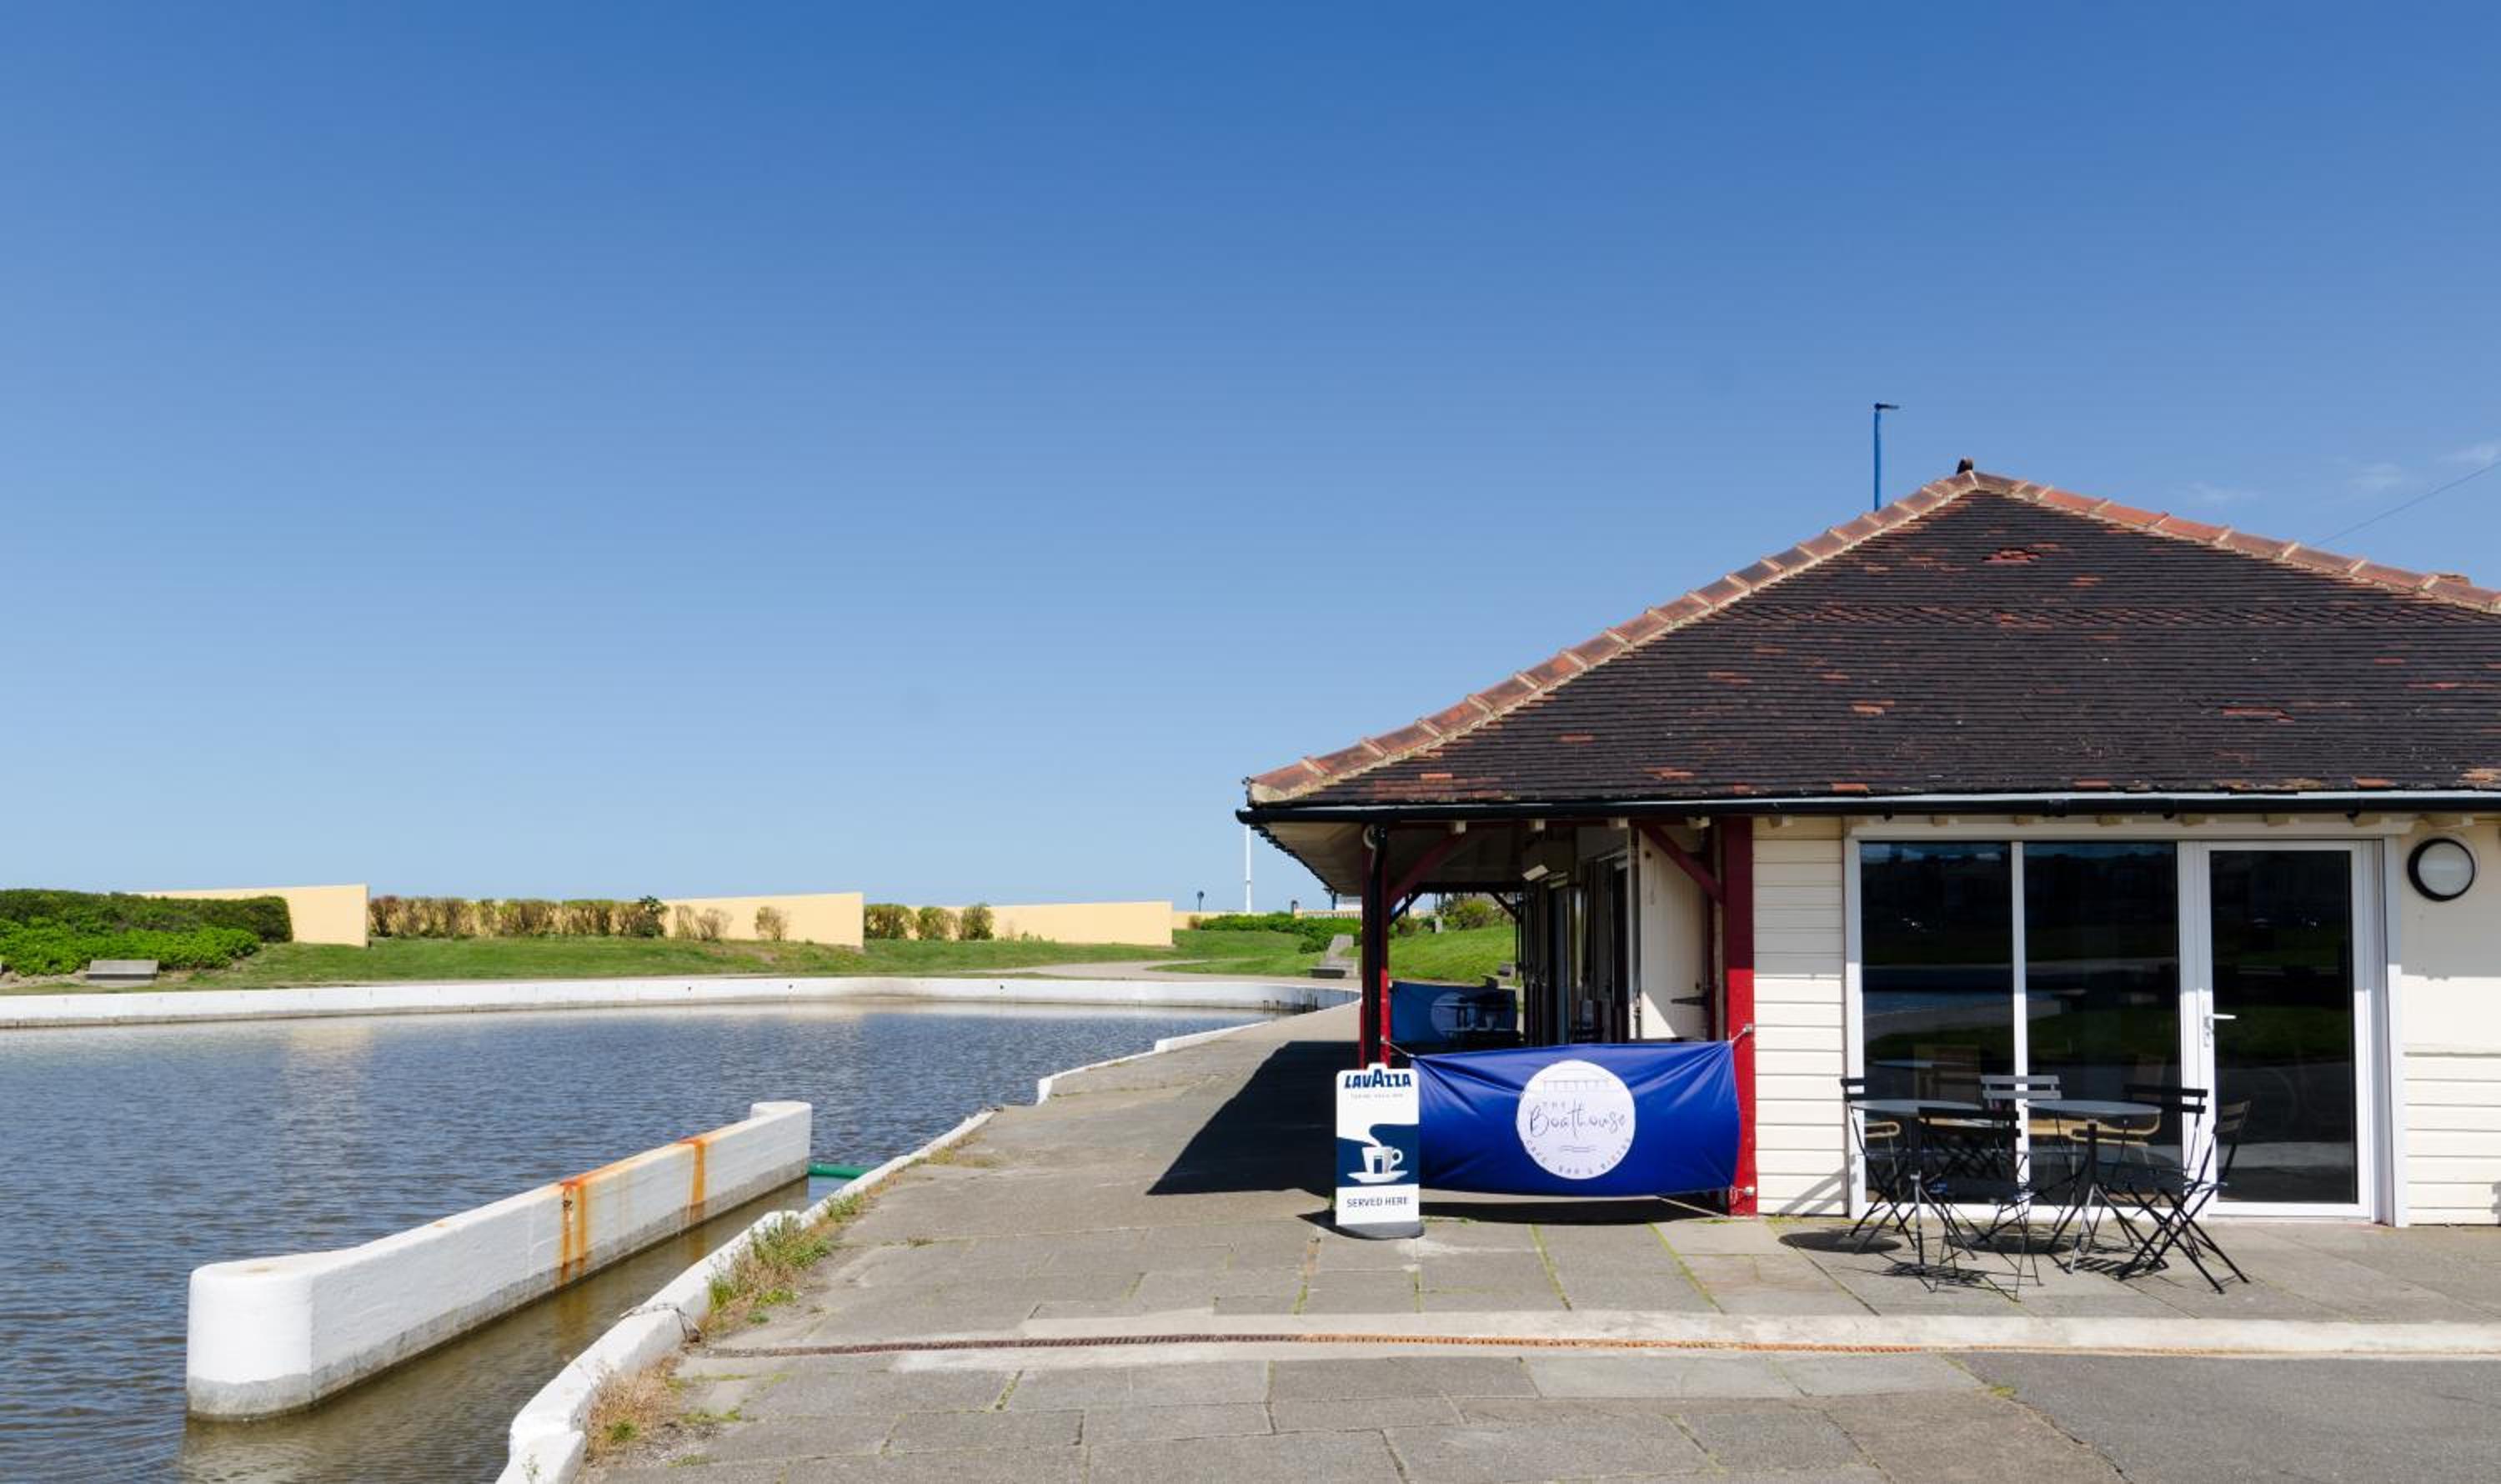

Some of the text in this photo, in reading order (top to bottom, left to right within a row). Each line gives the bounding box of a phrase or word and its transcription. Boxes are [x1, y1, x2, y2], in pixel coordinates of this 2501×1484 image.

[1344, 1068, 1412, 1089] LAVAZZA
[1530, 1099, 1626, 1140] Boathouse
[1346, 1196, 1408, 1208] SERVED HERE
